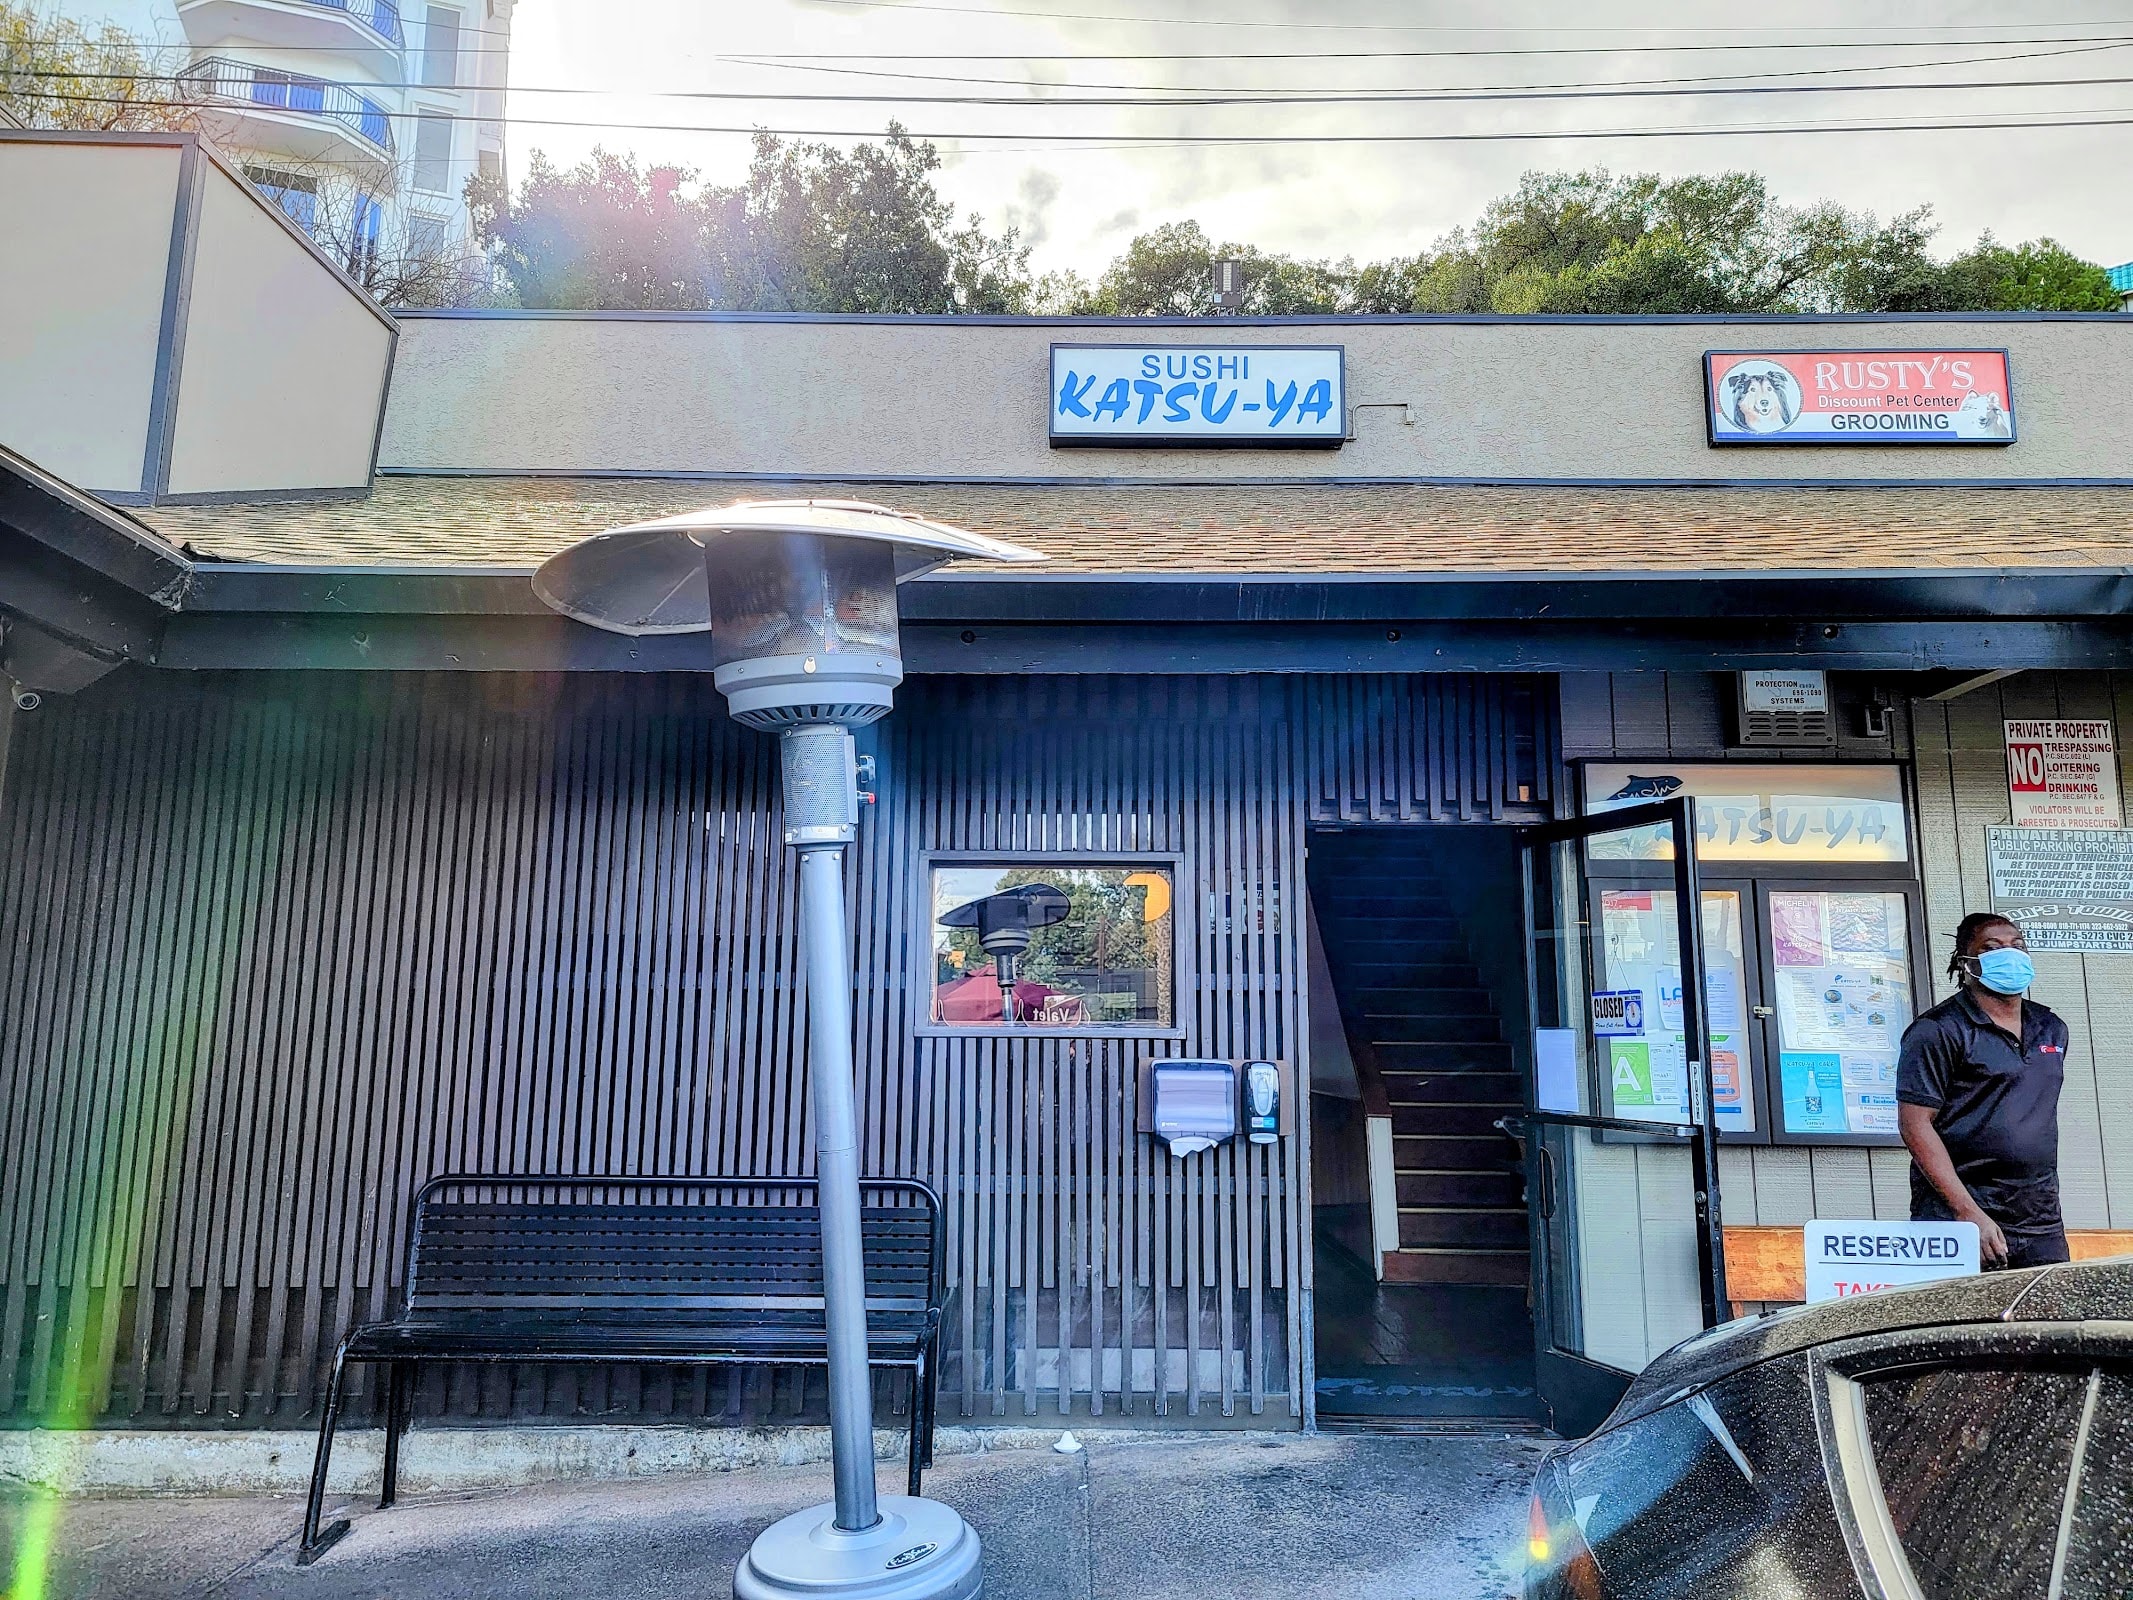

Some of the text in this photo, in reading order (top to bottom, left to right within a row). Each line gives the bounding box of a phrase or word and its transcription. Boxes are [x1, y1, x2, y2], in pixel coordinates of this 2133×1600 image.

[1141, 354, 1249, 380] SUSHI
[1815, 355, 1975, 392] RUSTY'S
[1058, 370, 1333, 428] KATSU-YA
[1818, 394, 1959, 408] Discount Pet Center
[1831, 413, 1950, 431] GROOMING
[2008, 722, 2109, 739] PRIVATE PROPERTY
[2044, 742, 2112, 753] TRESPASSING
[2010, 747, 2044, 786] NO
[2046, 763, 2101, 773] LOITERING
[2048, 783, 2098, 793] DRINKING
[2029, 805, 2105, 815] VIOLATORS WILL BE
[2017, 818, 2119, 829] ARRESTED & PROSECUTED
[1990, 829, 2059, 841] PRIVATE
[1991, 840, 2031, 851] PUBLIC
[2033, 841, 2082, 853] PARKING
[1999, 852, 2073, 861] UNAUTHORIZED
[2074, 854, 2121, 862] VEHICLES
[2010, 861, 2024, 869] BE
[2025, 861, 2060, 870] TOWED
[2076, 863, 2095, 871] THE
[1995, 870, 2039, 878] OWNERS
[2040, 871, 2083, 879] EXPENSE
[2004, 879, 2027, 887] THIS
[2028, 880, 2079, 889] PROPERTY
[2093, 881, 2131, 890] CLOSED
[2026, 889, 2064, 897] PUBLIC
[2086, 891, 2122, 899] PUBLIC
[2034, 931, 2104, 940] 1-877-275-5273
[2106, 932, 2126, 940] CVC
[1594, 997, 1624, 1018] CLOSED
[1612, 1056, 1642, 1091] A
[1823, 1236, 1959, 1258] RESERVED
